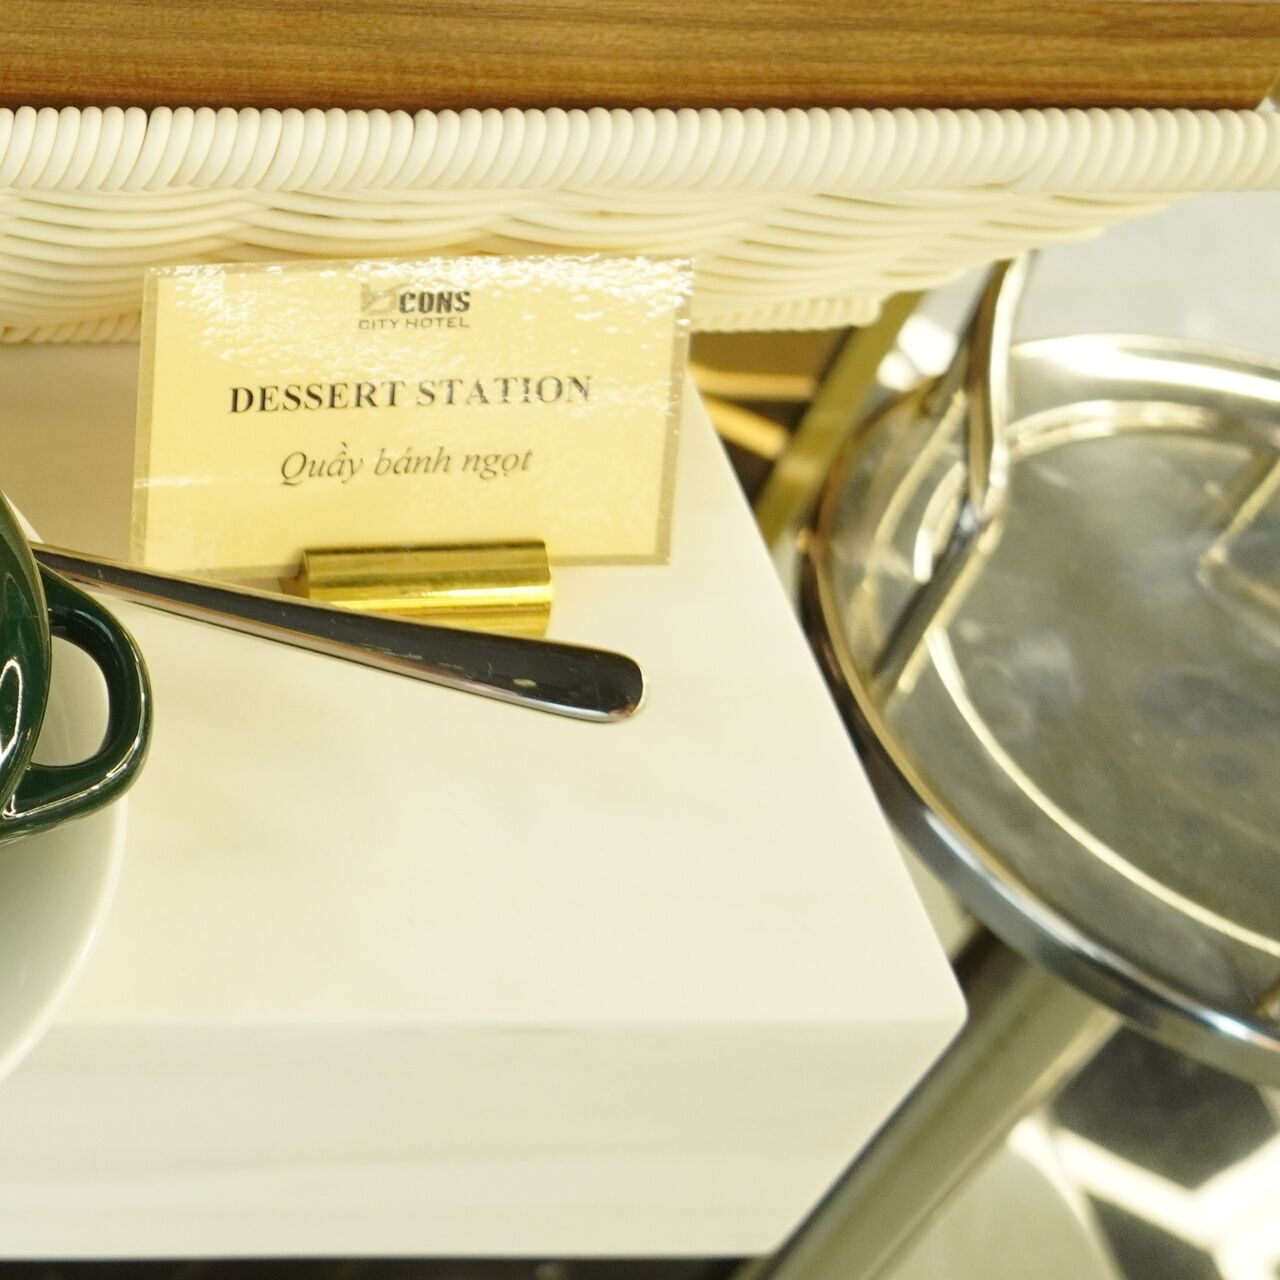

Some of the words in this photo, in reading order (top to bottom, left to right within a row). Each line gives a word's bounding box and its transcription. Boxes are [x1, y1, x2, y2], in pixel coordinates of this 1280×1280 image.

[358, 319, 399, 330] CITY
[405, 317, 470, 329] HOTEL
[229, 380, 406, 413] DESSERT
[416, 375, 594, 406] STATION
[280, 441, 364, 486] Quầy
[374, 446, 450, 477] bánh
[461, 447, 533, 479] ngọt
